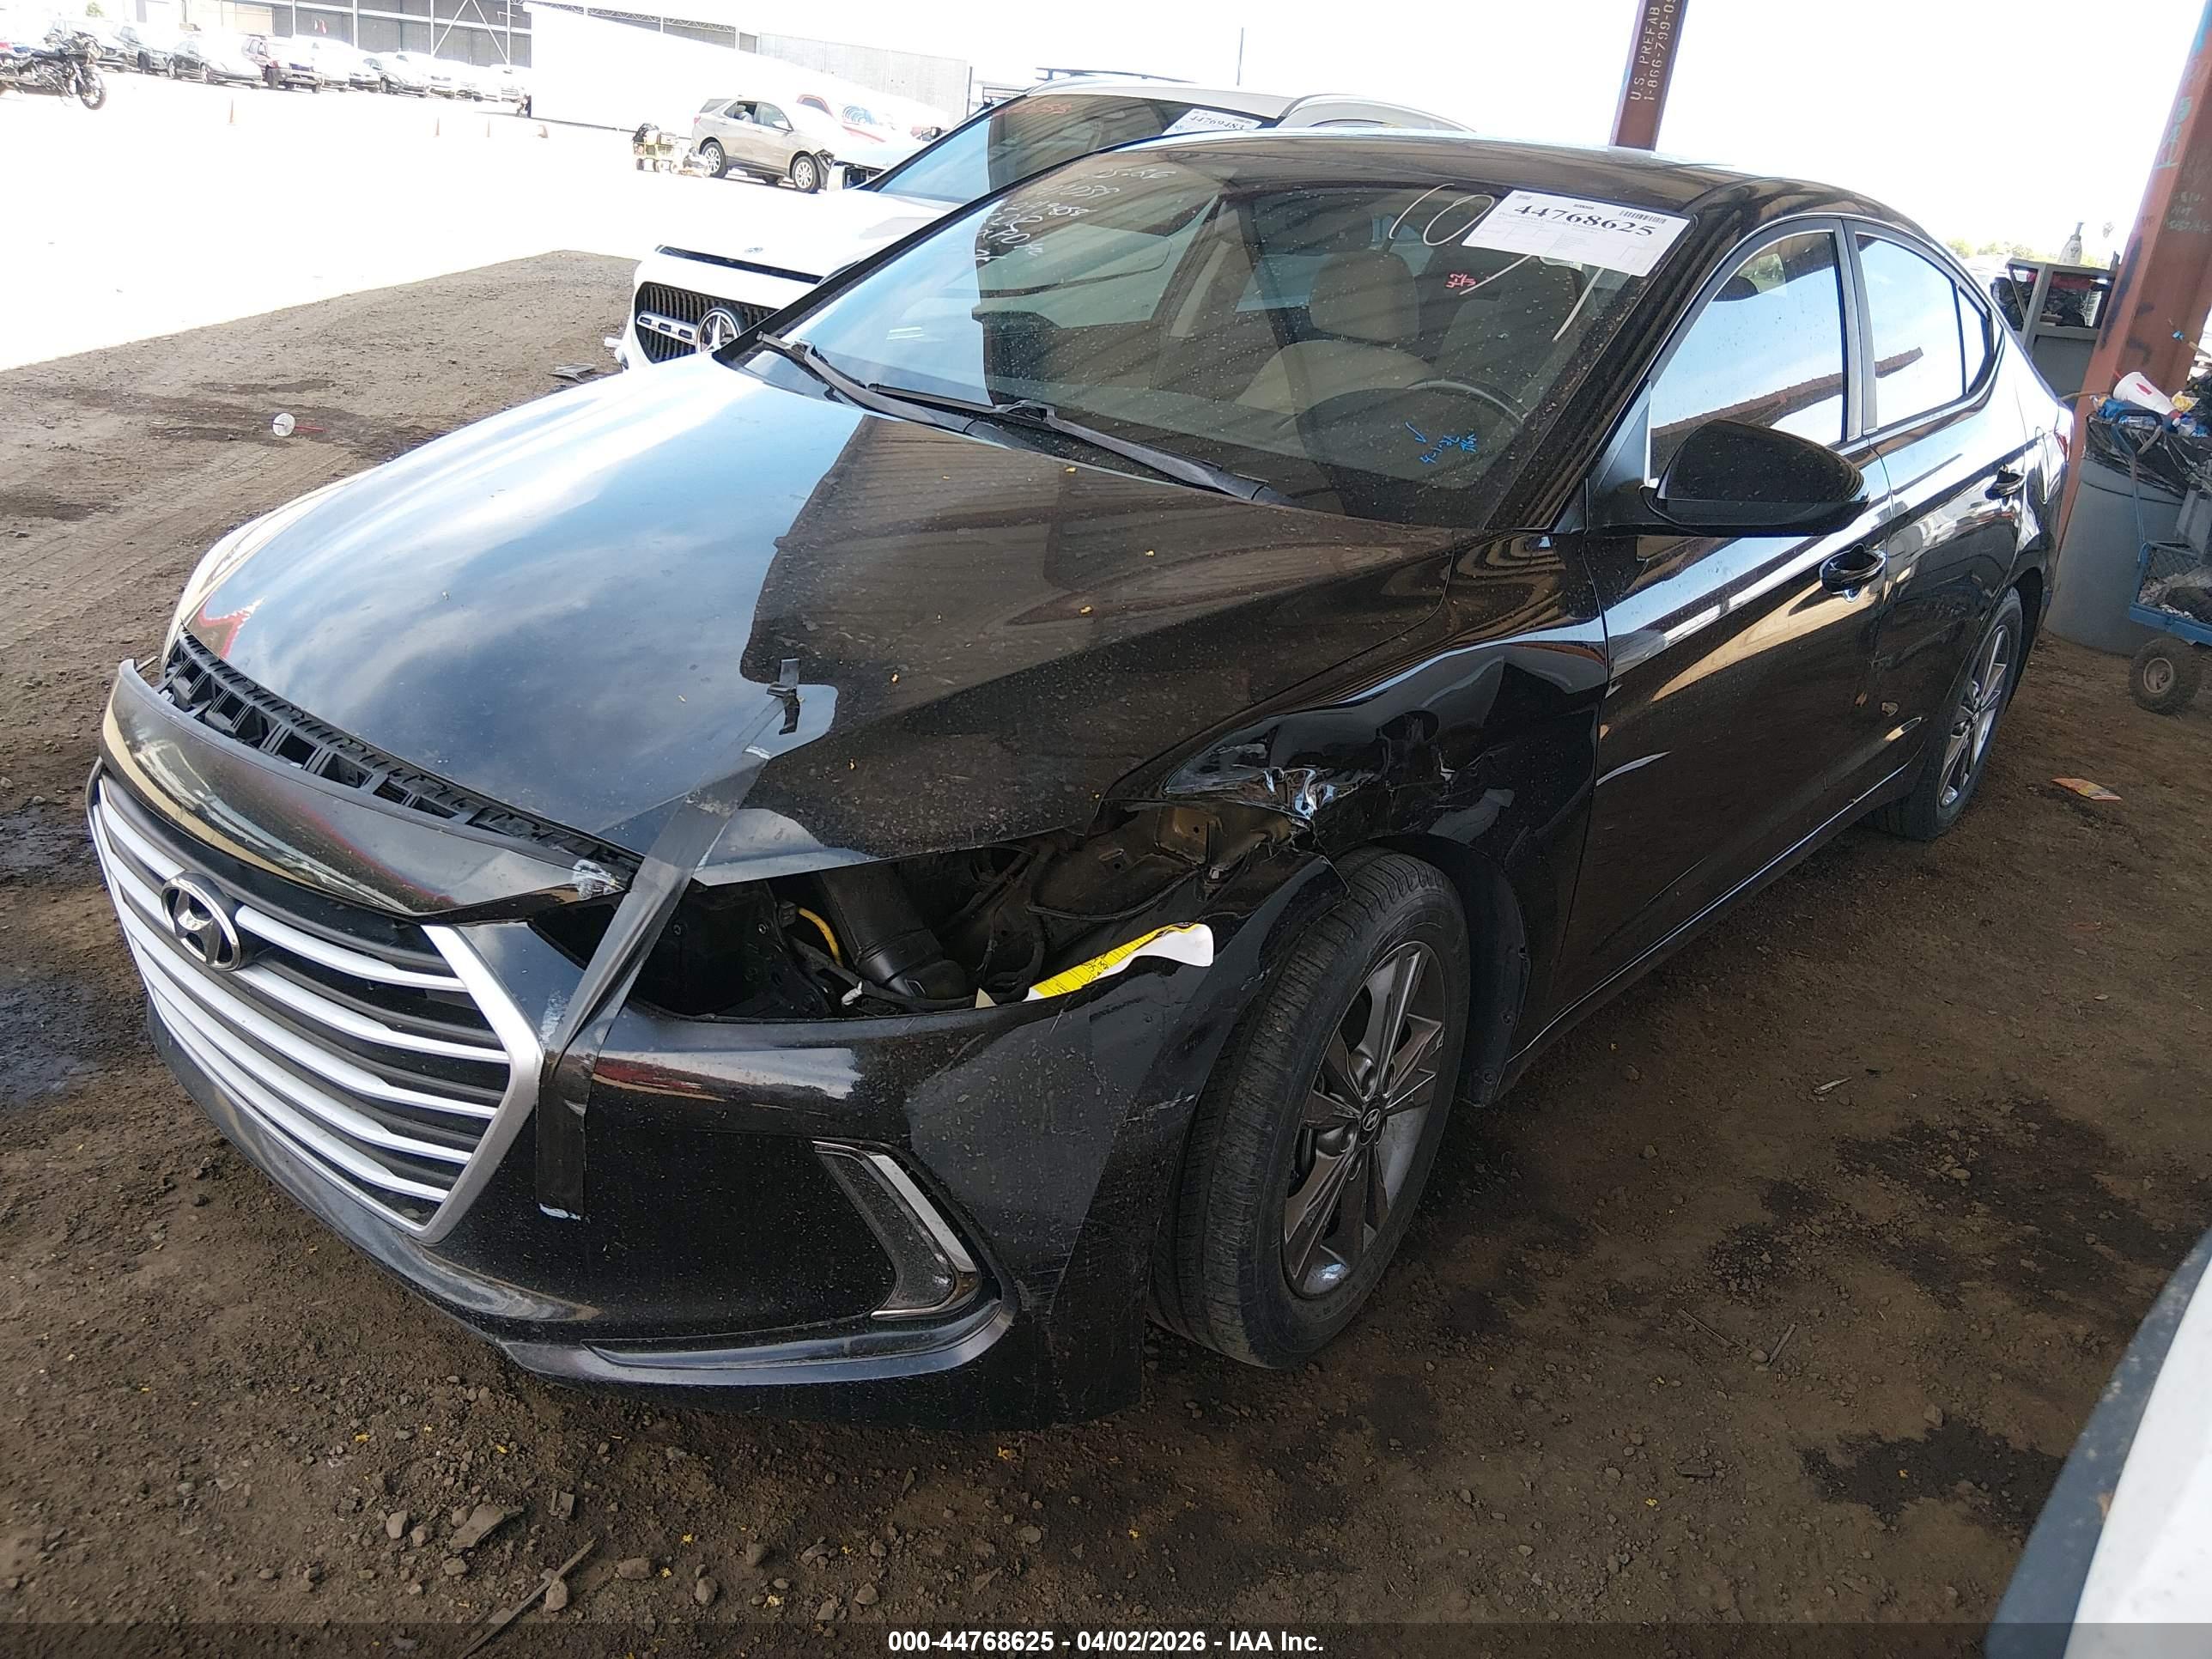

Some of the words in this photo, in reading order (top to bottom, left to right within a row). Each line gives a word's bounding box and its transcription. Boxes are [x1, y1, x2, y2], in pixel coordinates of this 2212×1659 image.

[1630, 73, 1647, 100] U.S.
[1639, 6, 1661, 64] PREFAB
[1644, 0, 1677, 100] 1-866-799-0
[1514, 204, 1657, 237] 44768625
